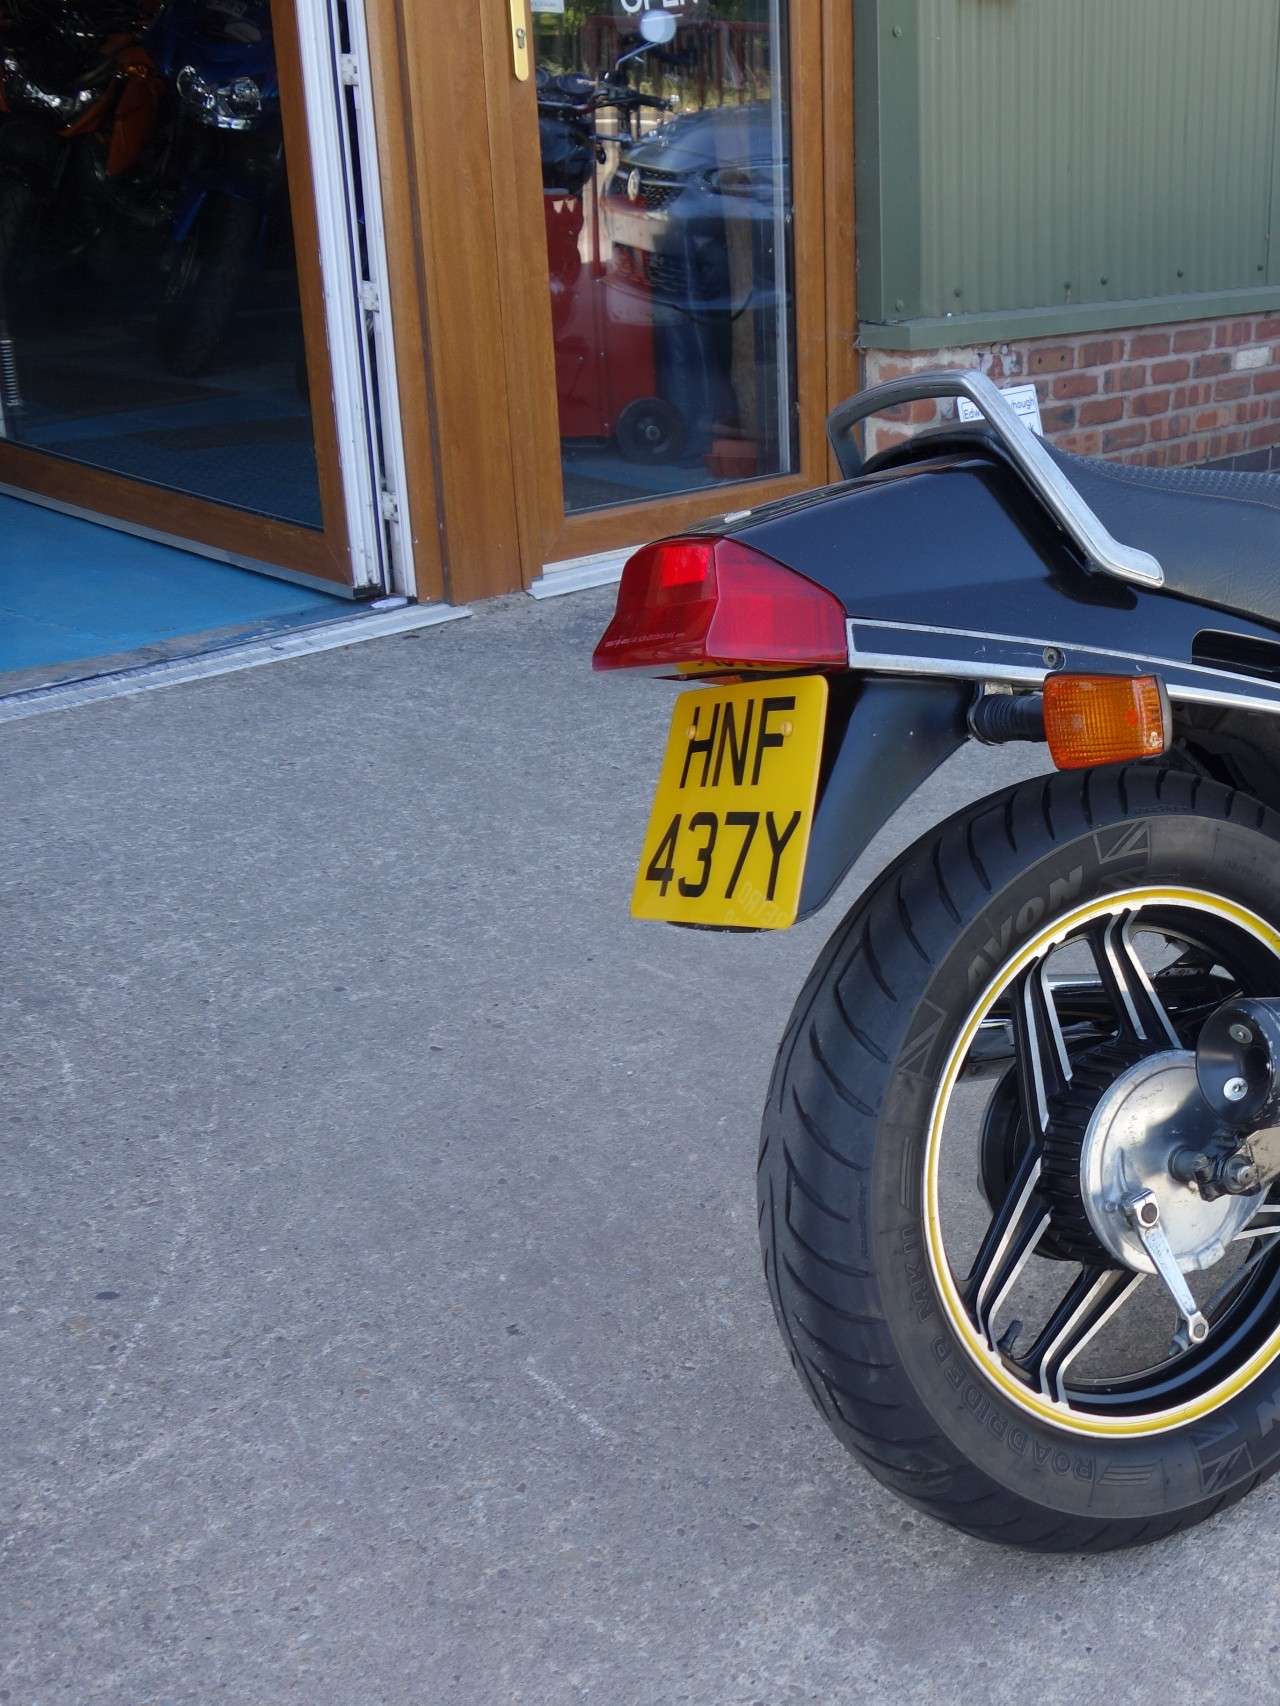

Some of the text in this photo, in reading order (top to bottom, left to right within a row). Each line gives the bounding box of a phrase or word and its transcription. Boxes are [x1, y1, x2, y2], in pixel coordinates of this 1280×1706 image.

[679, 696, 797, 789] HNF
[645, 810, 802, 902] 437Y
[966, 864, 1084, 1000] AVON
[929, 1336, 1097, 1482] ROADRIDER
